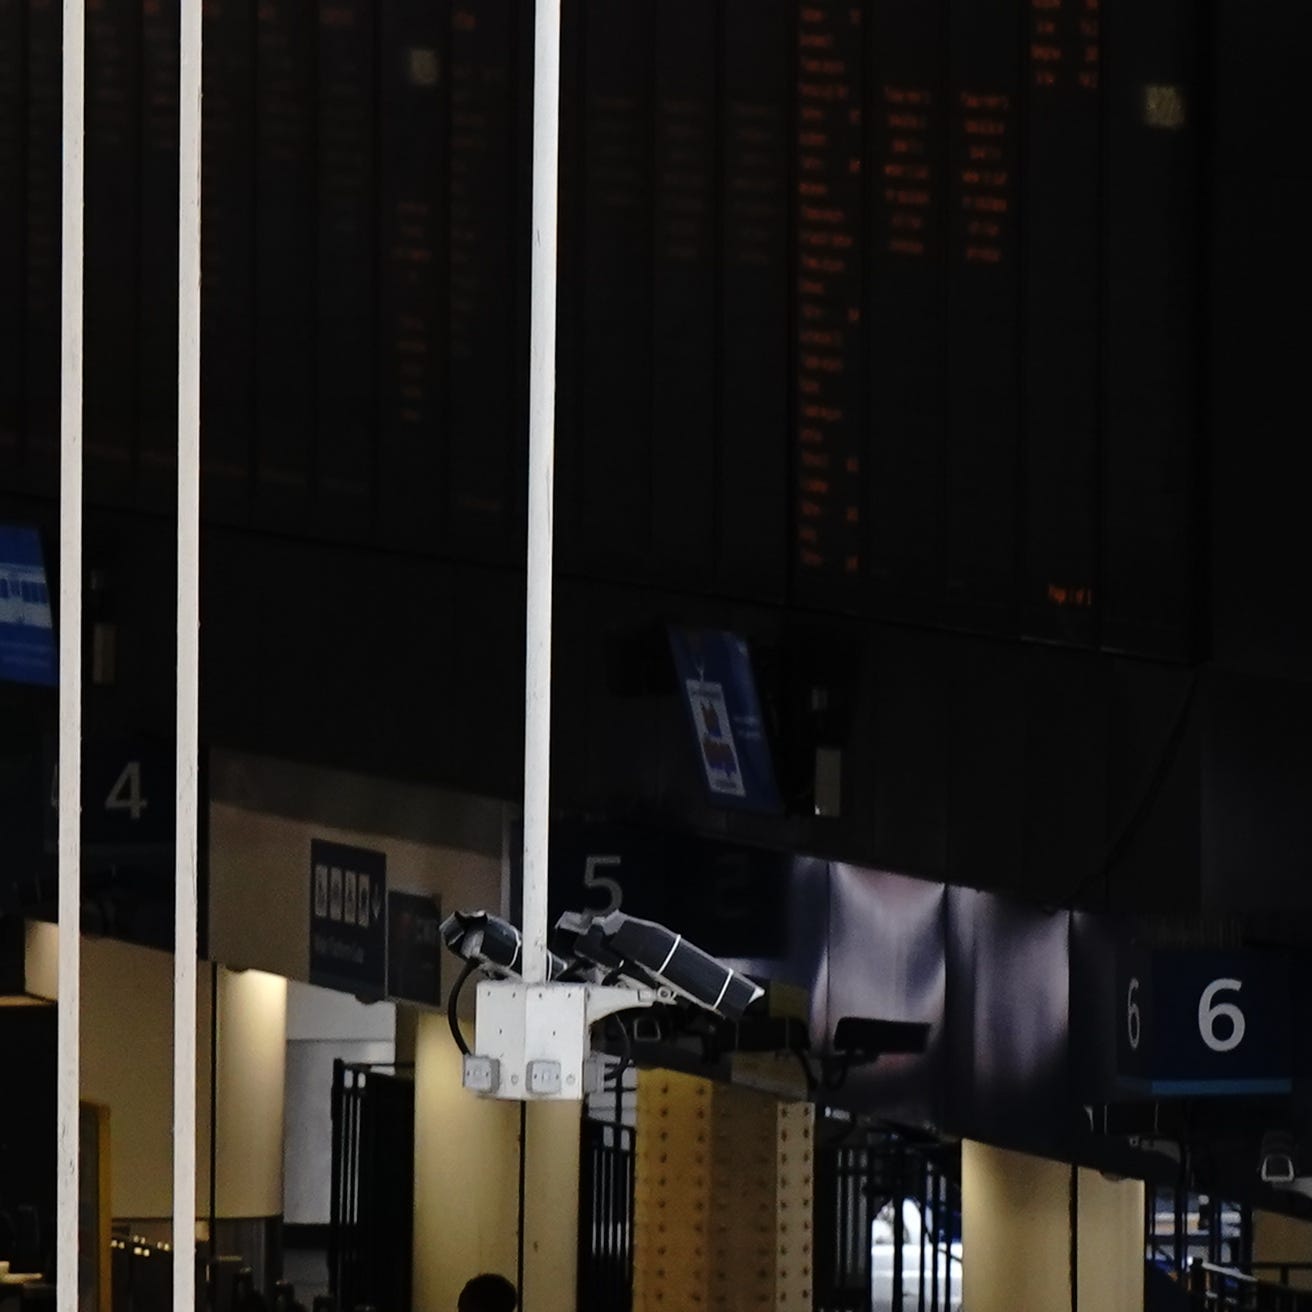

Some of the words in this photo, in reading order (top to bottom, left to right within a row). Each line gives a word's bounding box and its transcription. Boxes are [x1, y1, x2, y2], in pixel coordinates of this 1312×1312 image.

[104, 761, 149, 820] 4
[583, 854, 624, 918] 5
[1126, 977, 1141, 1050] 6
[1197, 977, 1247, 1052] 6
